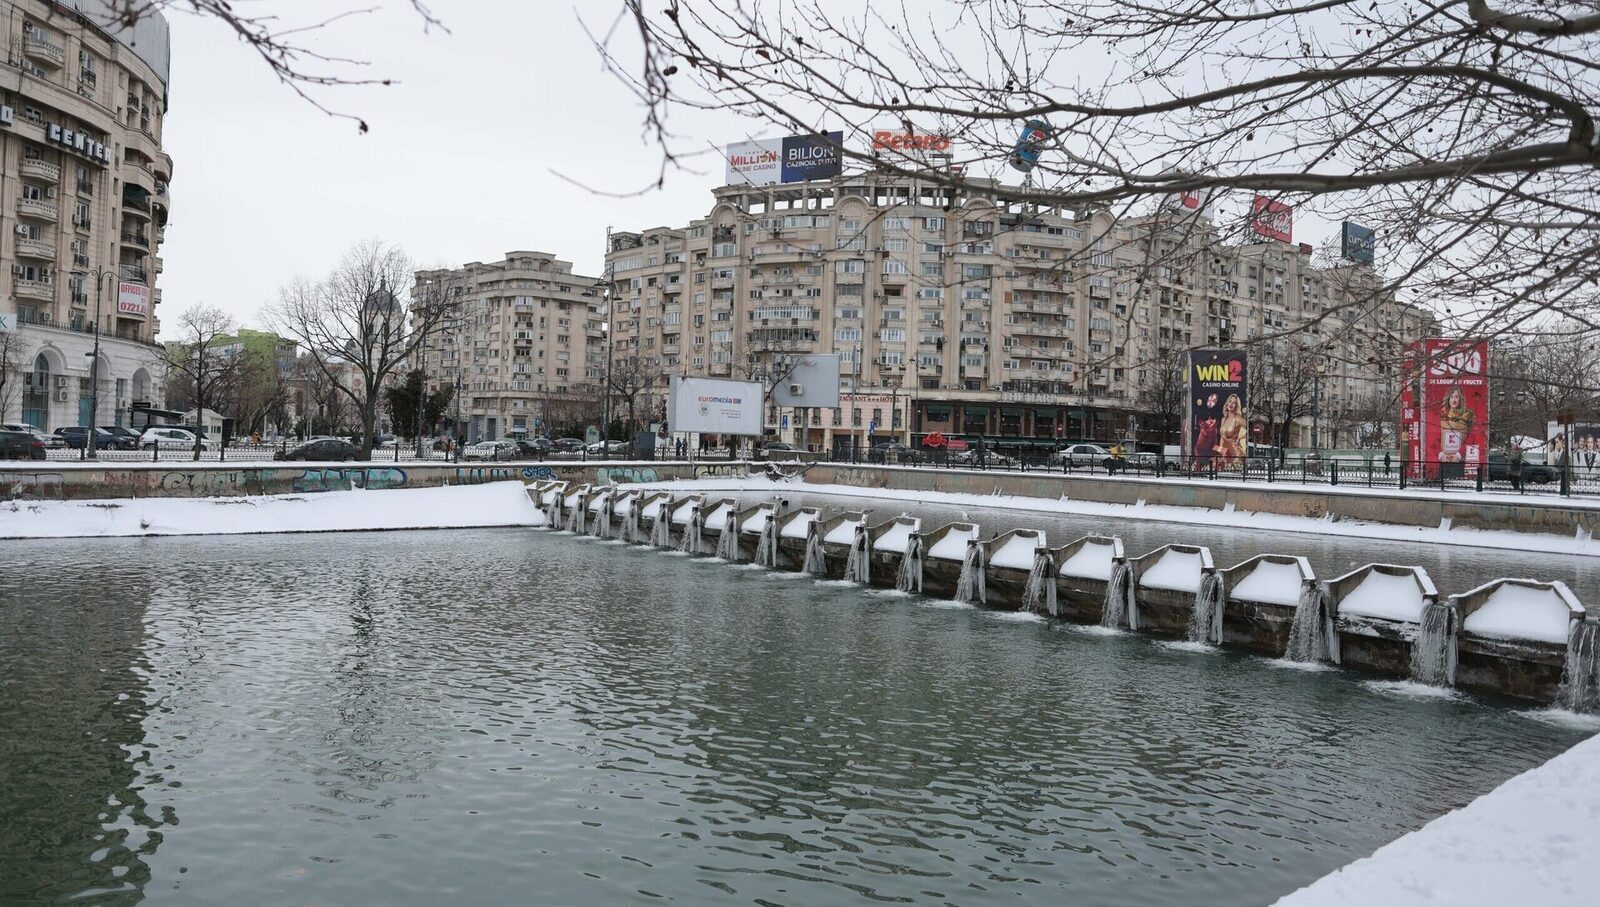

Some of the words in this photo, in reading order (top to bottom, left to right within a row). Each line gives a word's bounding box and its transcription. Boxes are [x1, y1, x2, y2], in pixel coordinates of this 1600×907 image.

[49, 123, 111, 161] CENTER
[873, 131, 950, 150] Betano
[789, 146, 834, 160] BILION
[121, 284, 141, 295] OFFICES
[1195, 360, 1242, 381] WIN2
